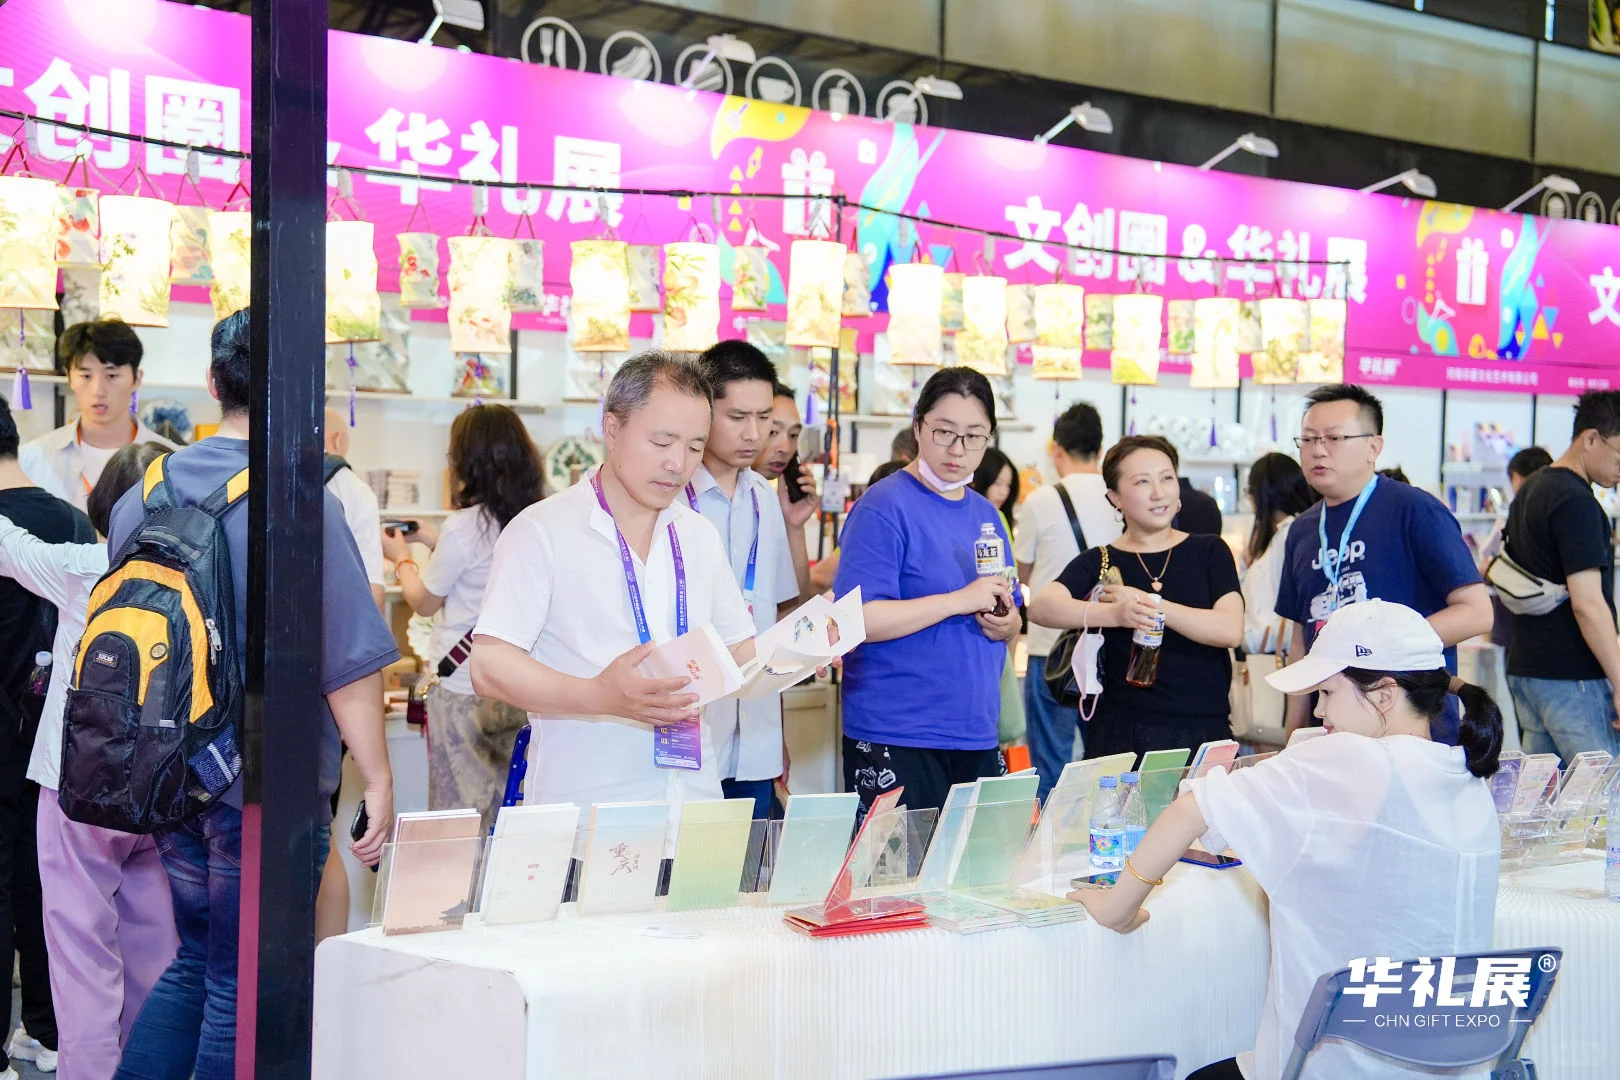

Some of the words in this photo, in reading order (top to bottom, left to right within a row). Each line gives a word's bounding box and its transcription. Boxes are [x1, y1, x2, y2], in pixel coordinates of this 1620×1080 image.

[364, 107, 624, 227] 华礼展
[1003, 195, 1168, 285] 文创圈
[1178, 223, 1217, 285] &
[1226, 223, 1368, 304] 华礼展
